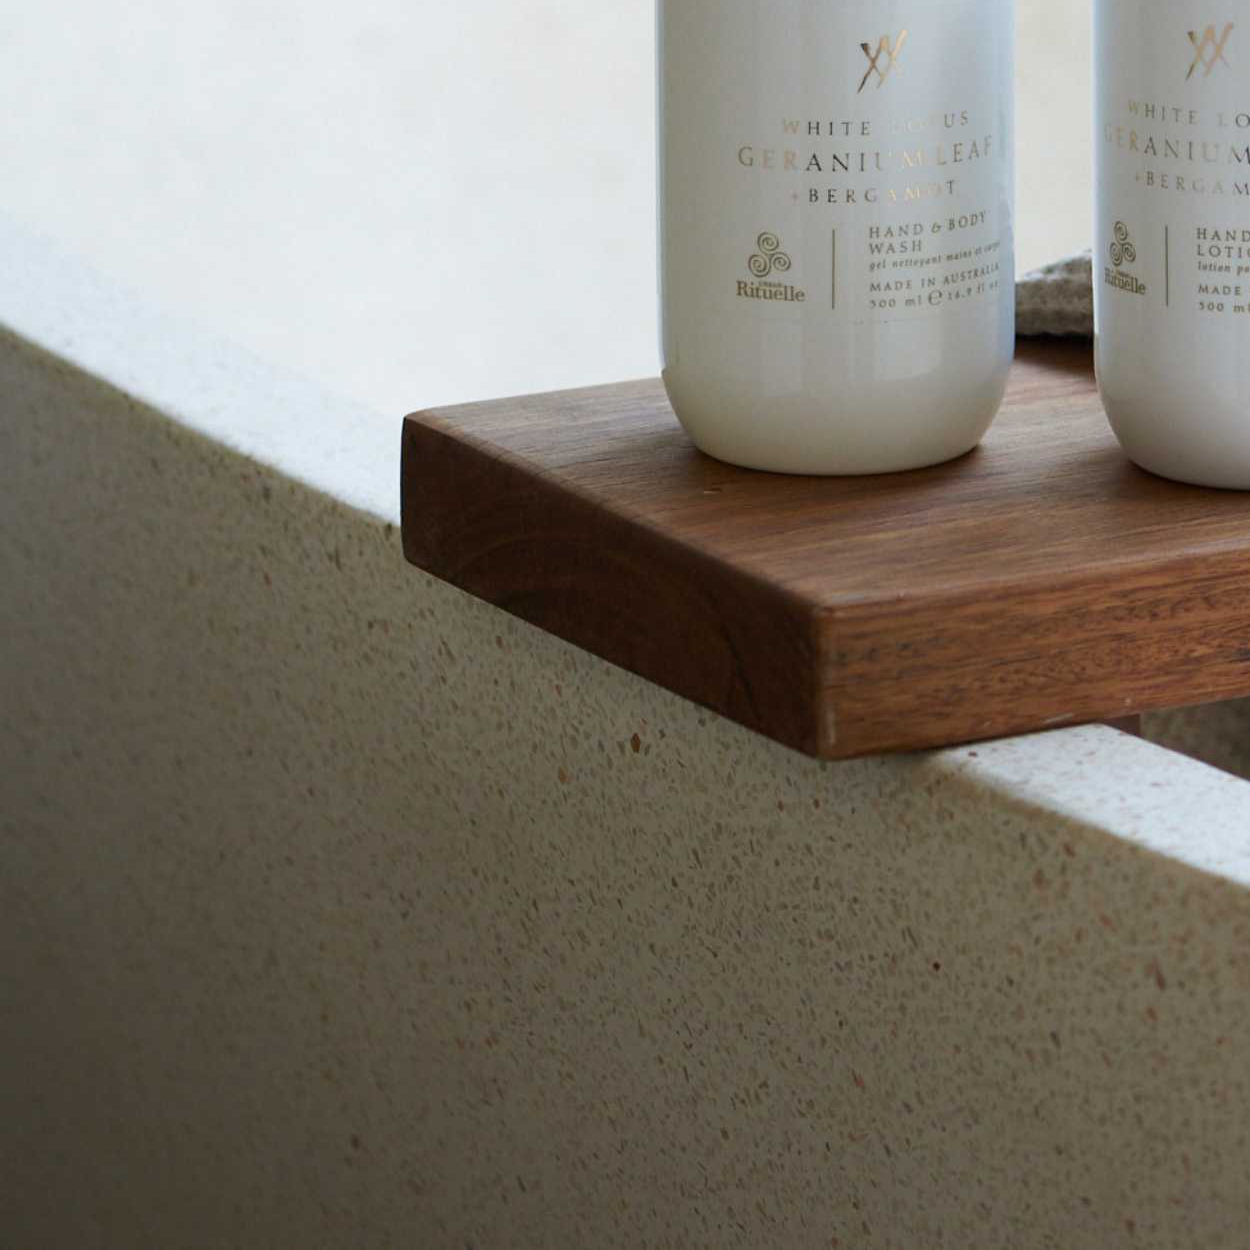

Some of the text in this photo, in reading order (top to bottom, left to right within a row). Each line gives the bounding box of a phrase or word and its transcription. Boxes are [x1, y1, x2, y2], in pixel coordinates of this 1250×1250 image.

[1127, 99, 1199, 126] WHITE
[782, 110, 970, 137] WHITE LOUS
[936, 134, 993, 166] LEAF
[868, 210, 987, 239] HAND & BODY
[868, 239, 923, 255] WASH
[868, 258, 886, 272] gel
[1197, 261, 1231, 272] lotion
[869, 261, 1000, 293] MADE IN AUSTRALIA
[736, 280, 806, 302] Rituelle
[1198, 283, 1243, 296] MADE
[905, 295, 923, 307] ml
[1198, 301, 1225, 312] 500
